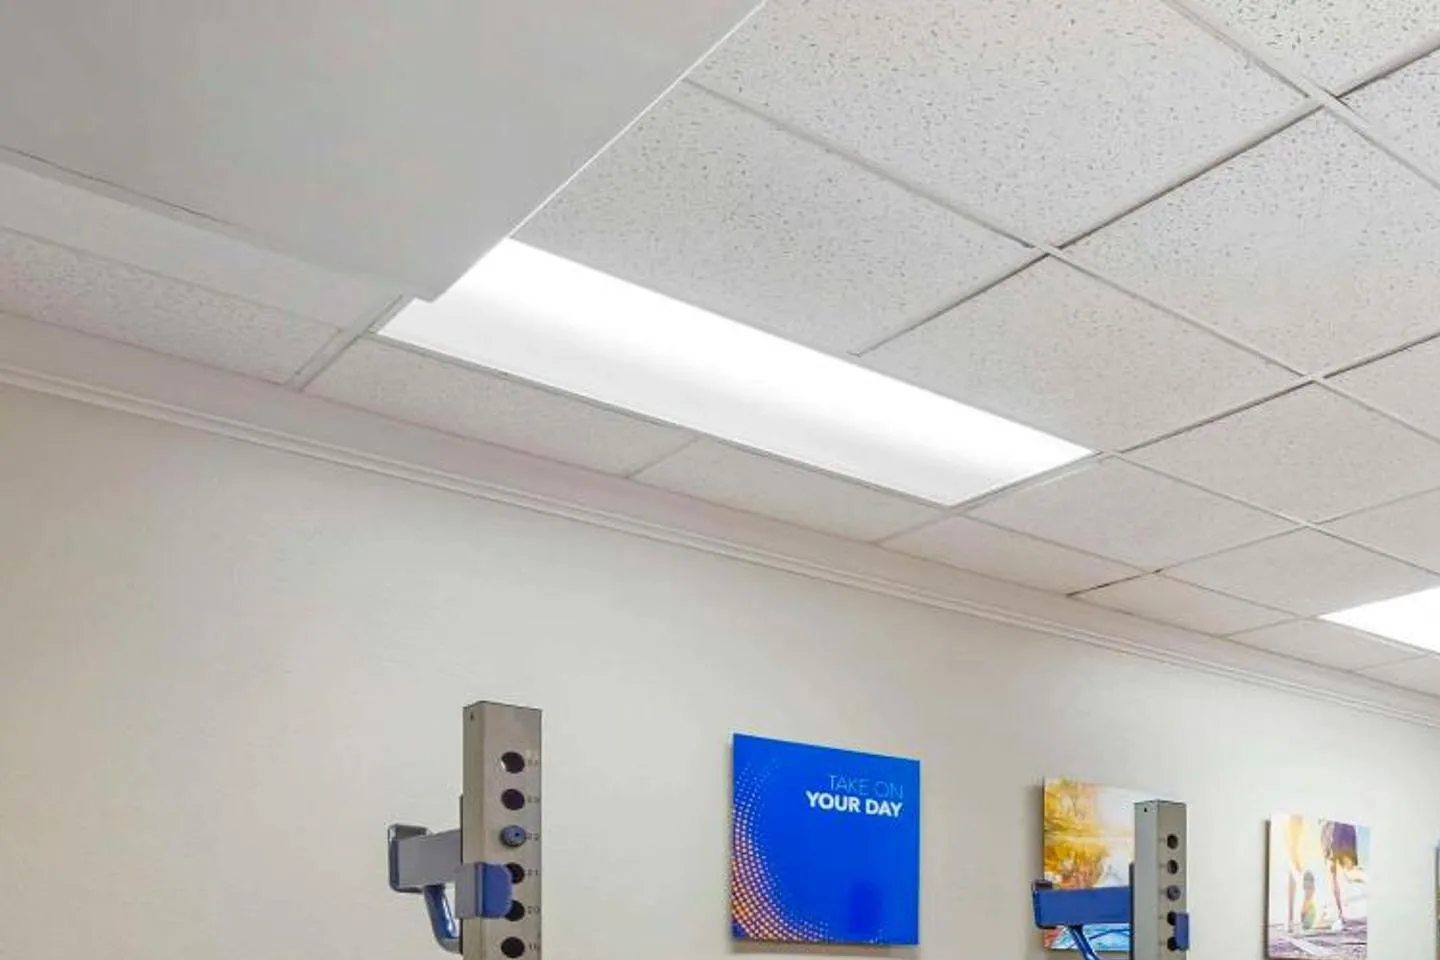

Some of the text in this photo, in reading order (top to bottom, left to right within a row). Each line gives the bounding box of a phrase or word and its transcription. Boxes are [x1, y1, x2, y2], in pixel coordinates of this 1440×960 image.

[829, 774, 904, 799] TAKE ON
[805, 791, 903, 817] YOUR DAY
